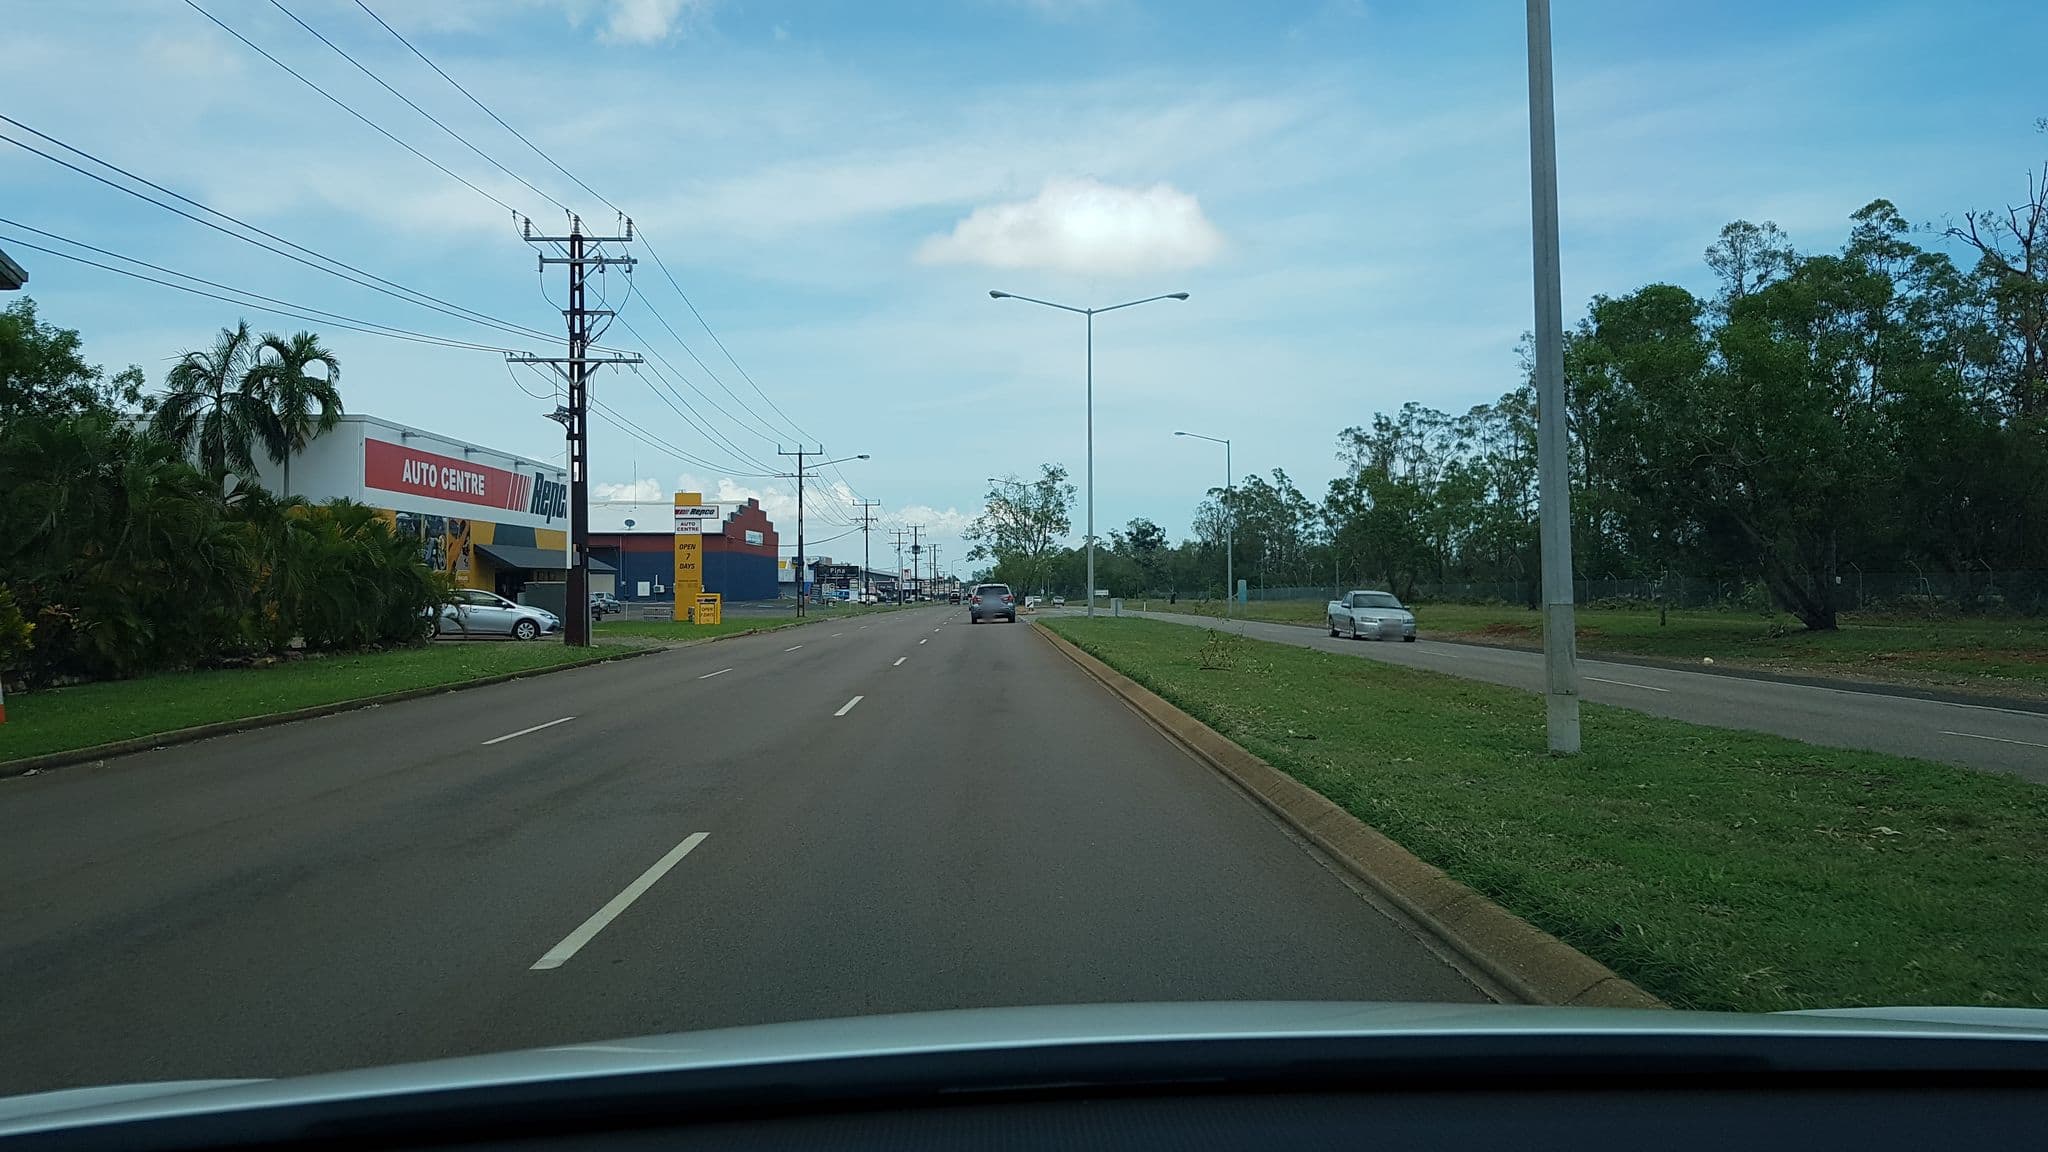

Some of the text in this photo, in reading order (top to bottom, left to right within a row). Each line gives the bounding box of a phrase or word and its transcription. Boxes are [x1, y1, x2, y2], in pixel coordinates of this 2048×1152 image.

[402, 459, 486, 496] AUTO CENTRE
[530, 471, 567, 524] Repc
[690, 508, 714, 516] Repco
